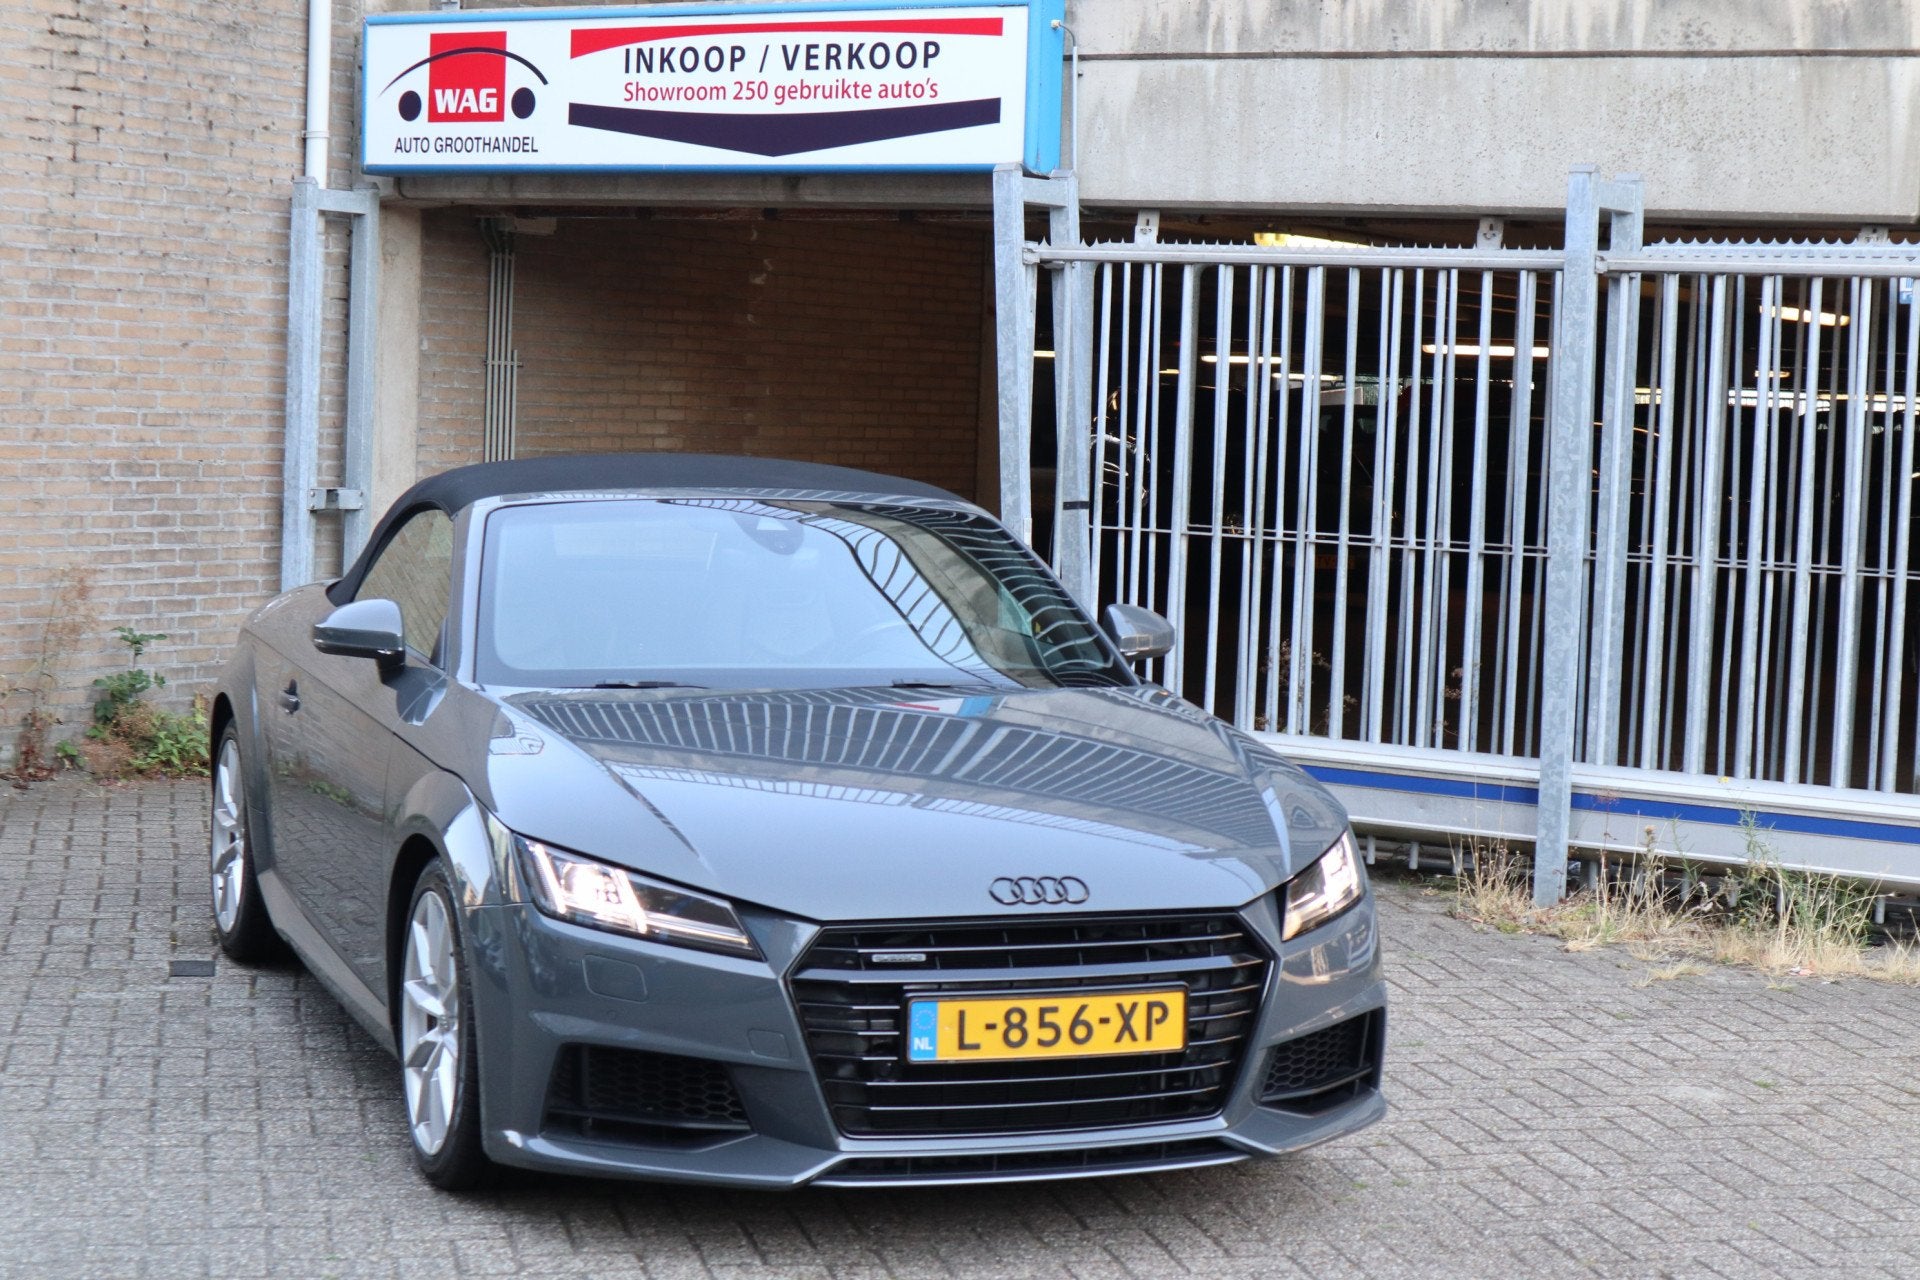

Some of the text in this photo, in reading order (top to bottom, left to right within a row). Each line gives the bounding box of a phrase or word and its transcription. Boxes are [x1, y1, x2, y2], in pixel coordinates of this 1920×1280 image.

[624, 41, 941, 74] INKOOP / VERKOOP
[434, 88, 498, 113] WAG
[624, 77, 938, 105] Showroom 250 gebruikte auto's
[395, 136, 538, 153] AUTO GROOTHANDEL
[957, 1000, 1169, 1051] L-856-XP
[913, 1036, 934, 1052] NL
